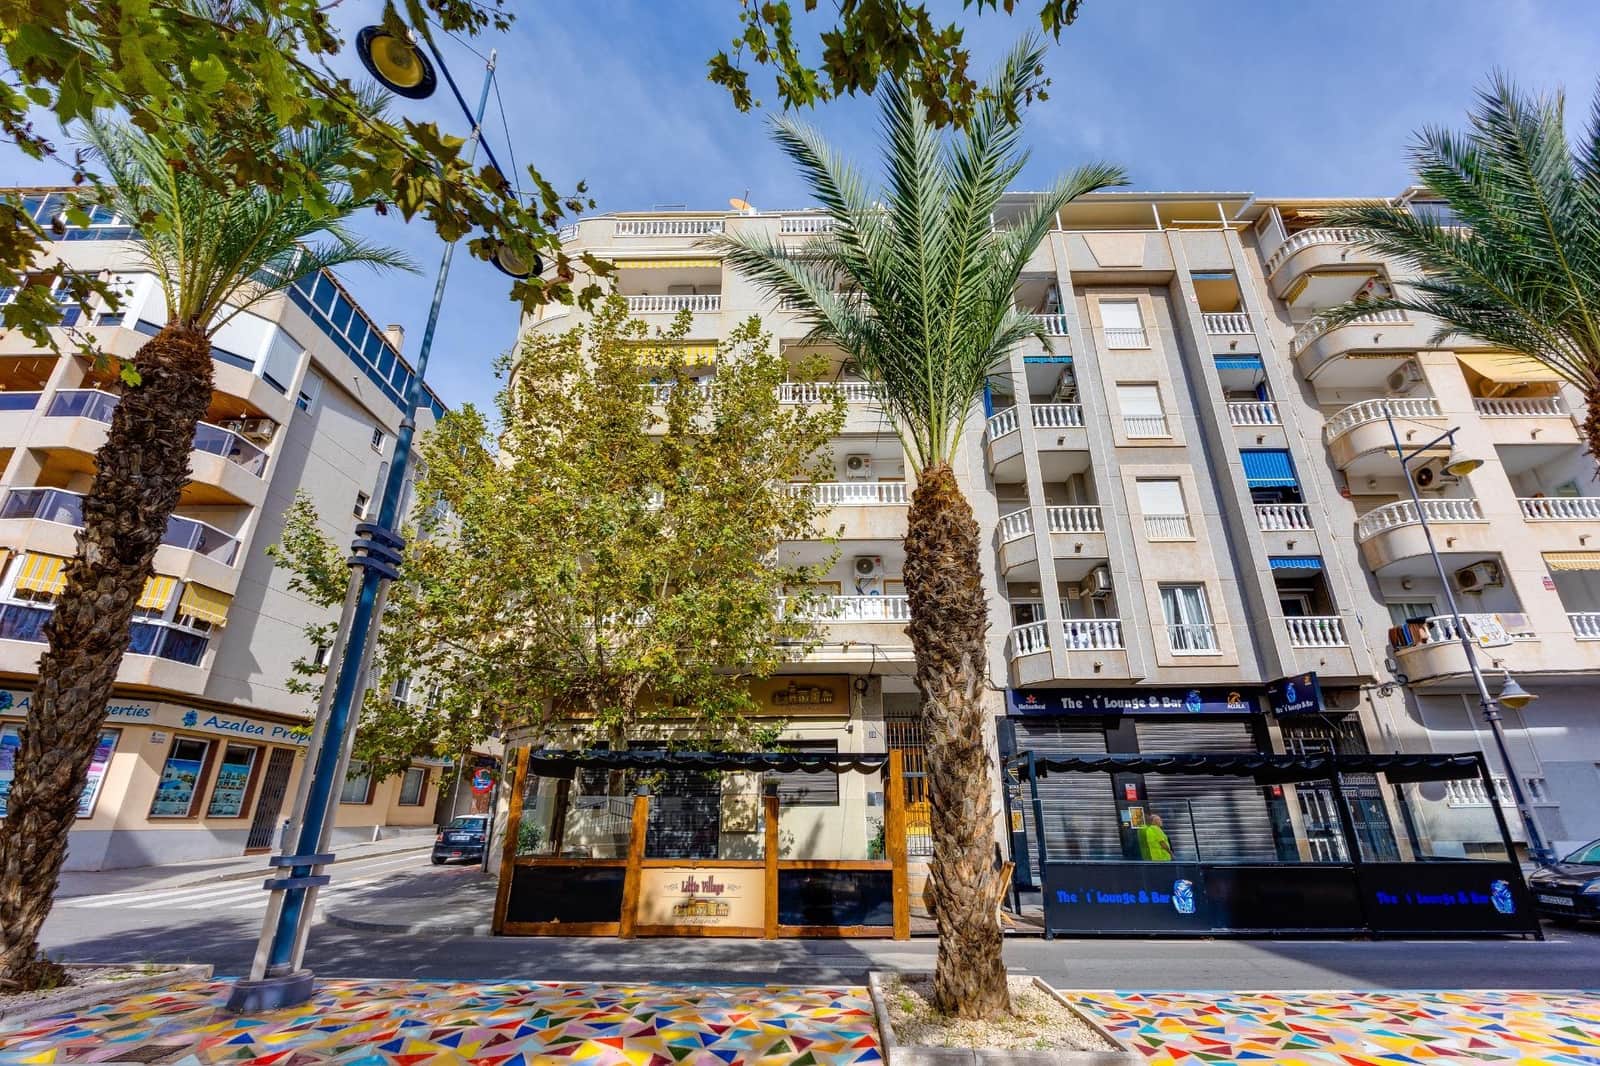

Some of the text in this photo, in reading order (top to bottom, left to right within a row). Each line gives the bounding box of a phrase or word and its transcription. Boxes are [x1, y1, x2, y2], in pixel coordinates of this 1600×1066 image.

[1061, 697, 1083, 709] The
[1104, 697, 1146, 709] Lounge
[1149, 696, 1160, 708] &
[1163, 697, 1182, 708] Bar
[203, 715, 265, 736] Azalea
[681, 874, 724, 896] Little Village
[1056, 890, 1078, 903] The
[1097, 891, 1136, 904] Lounge
[1138, 889, 1150, 903] &
[1151, 891, 1170, 903] Bar
